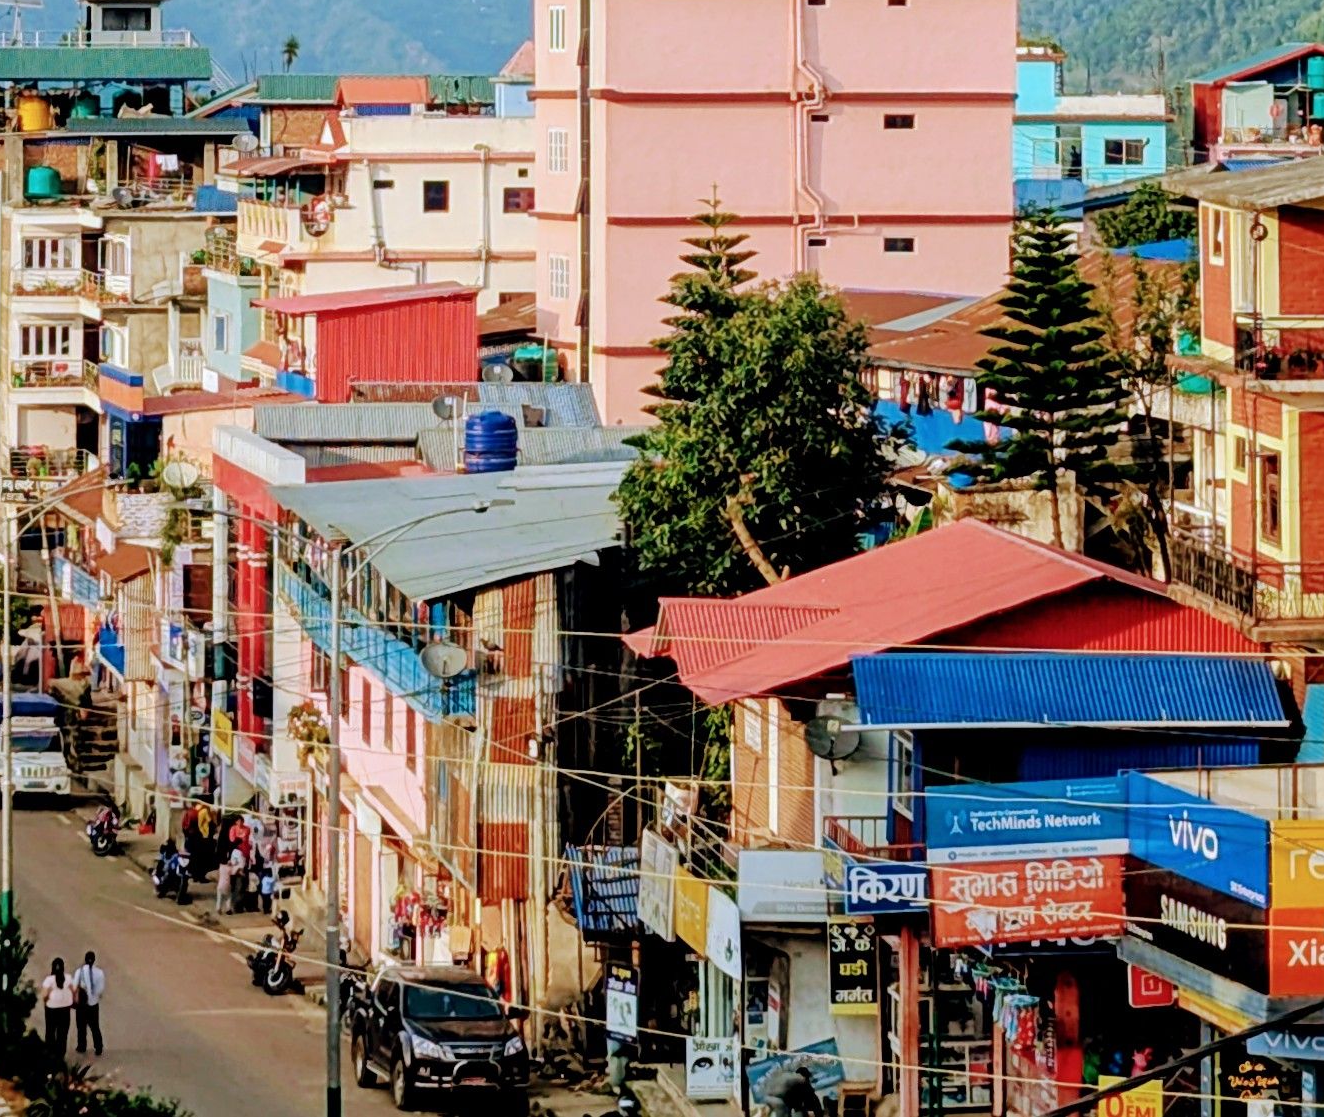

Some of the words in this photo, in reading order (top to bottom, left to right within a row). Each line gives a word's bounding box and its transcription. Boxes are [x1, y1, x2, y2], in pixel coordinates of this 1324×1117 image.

[970, 815, 1042, 832] TechMinds
[1044, 812, 1102, 828] Network
[1168, 809, 1219, 860] vivo
[848, 866, 927, 904] किरण
[1160, 893, 1228, 952] SAMSUNG
